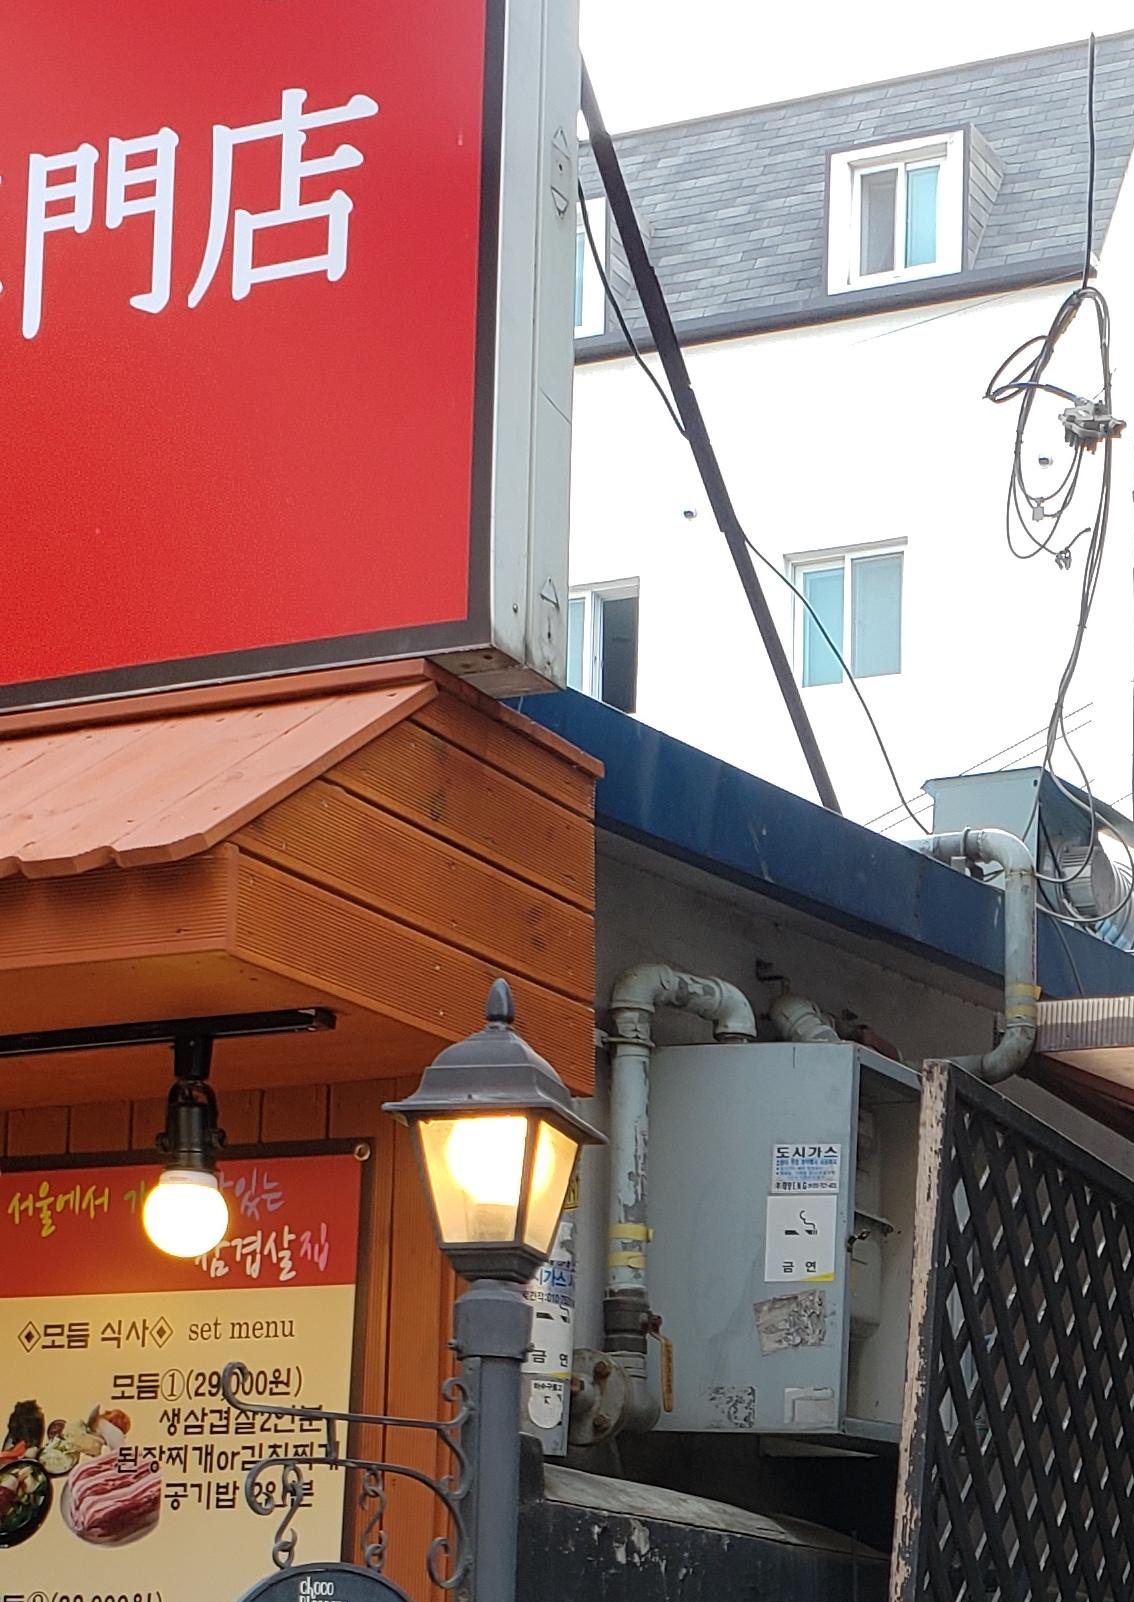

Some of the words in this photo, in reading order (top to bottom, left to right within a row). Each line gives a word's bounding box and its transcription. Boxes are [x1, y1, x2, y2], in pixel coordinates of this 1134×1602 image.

[0, 88, 379, 340] 門店
[775, 1146, 839, 1159] 도시가스
[7, 1181, 110, 1238] 서울에서
[41, 1322, 90, 1350] 모듬
[100, 1319, 149, 1349] 식사
[188, 1316, 222, 1342] set
[229, 1317, 296, 1340] menu
[164, 1480, 240, 1511] 공기밥
[299, 1576, 335, 1600] choco
